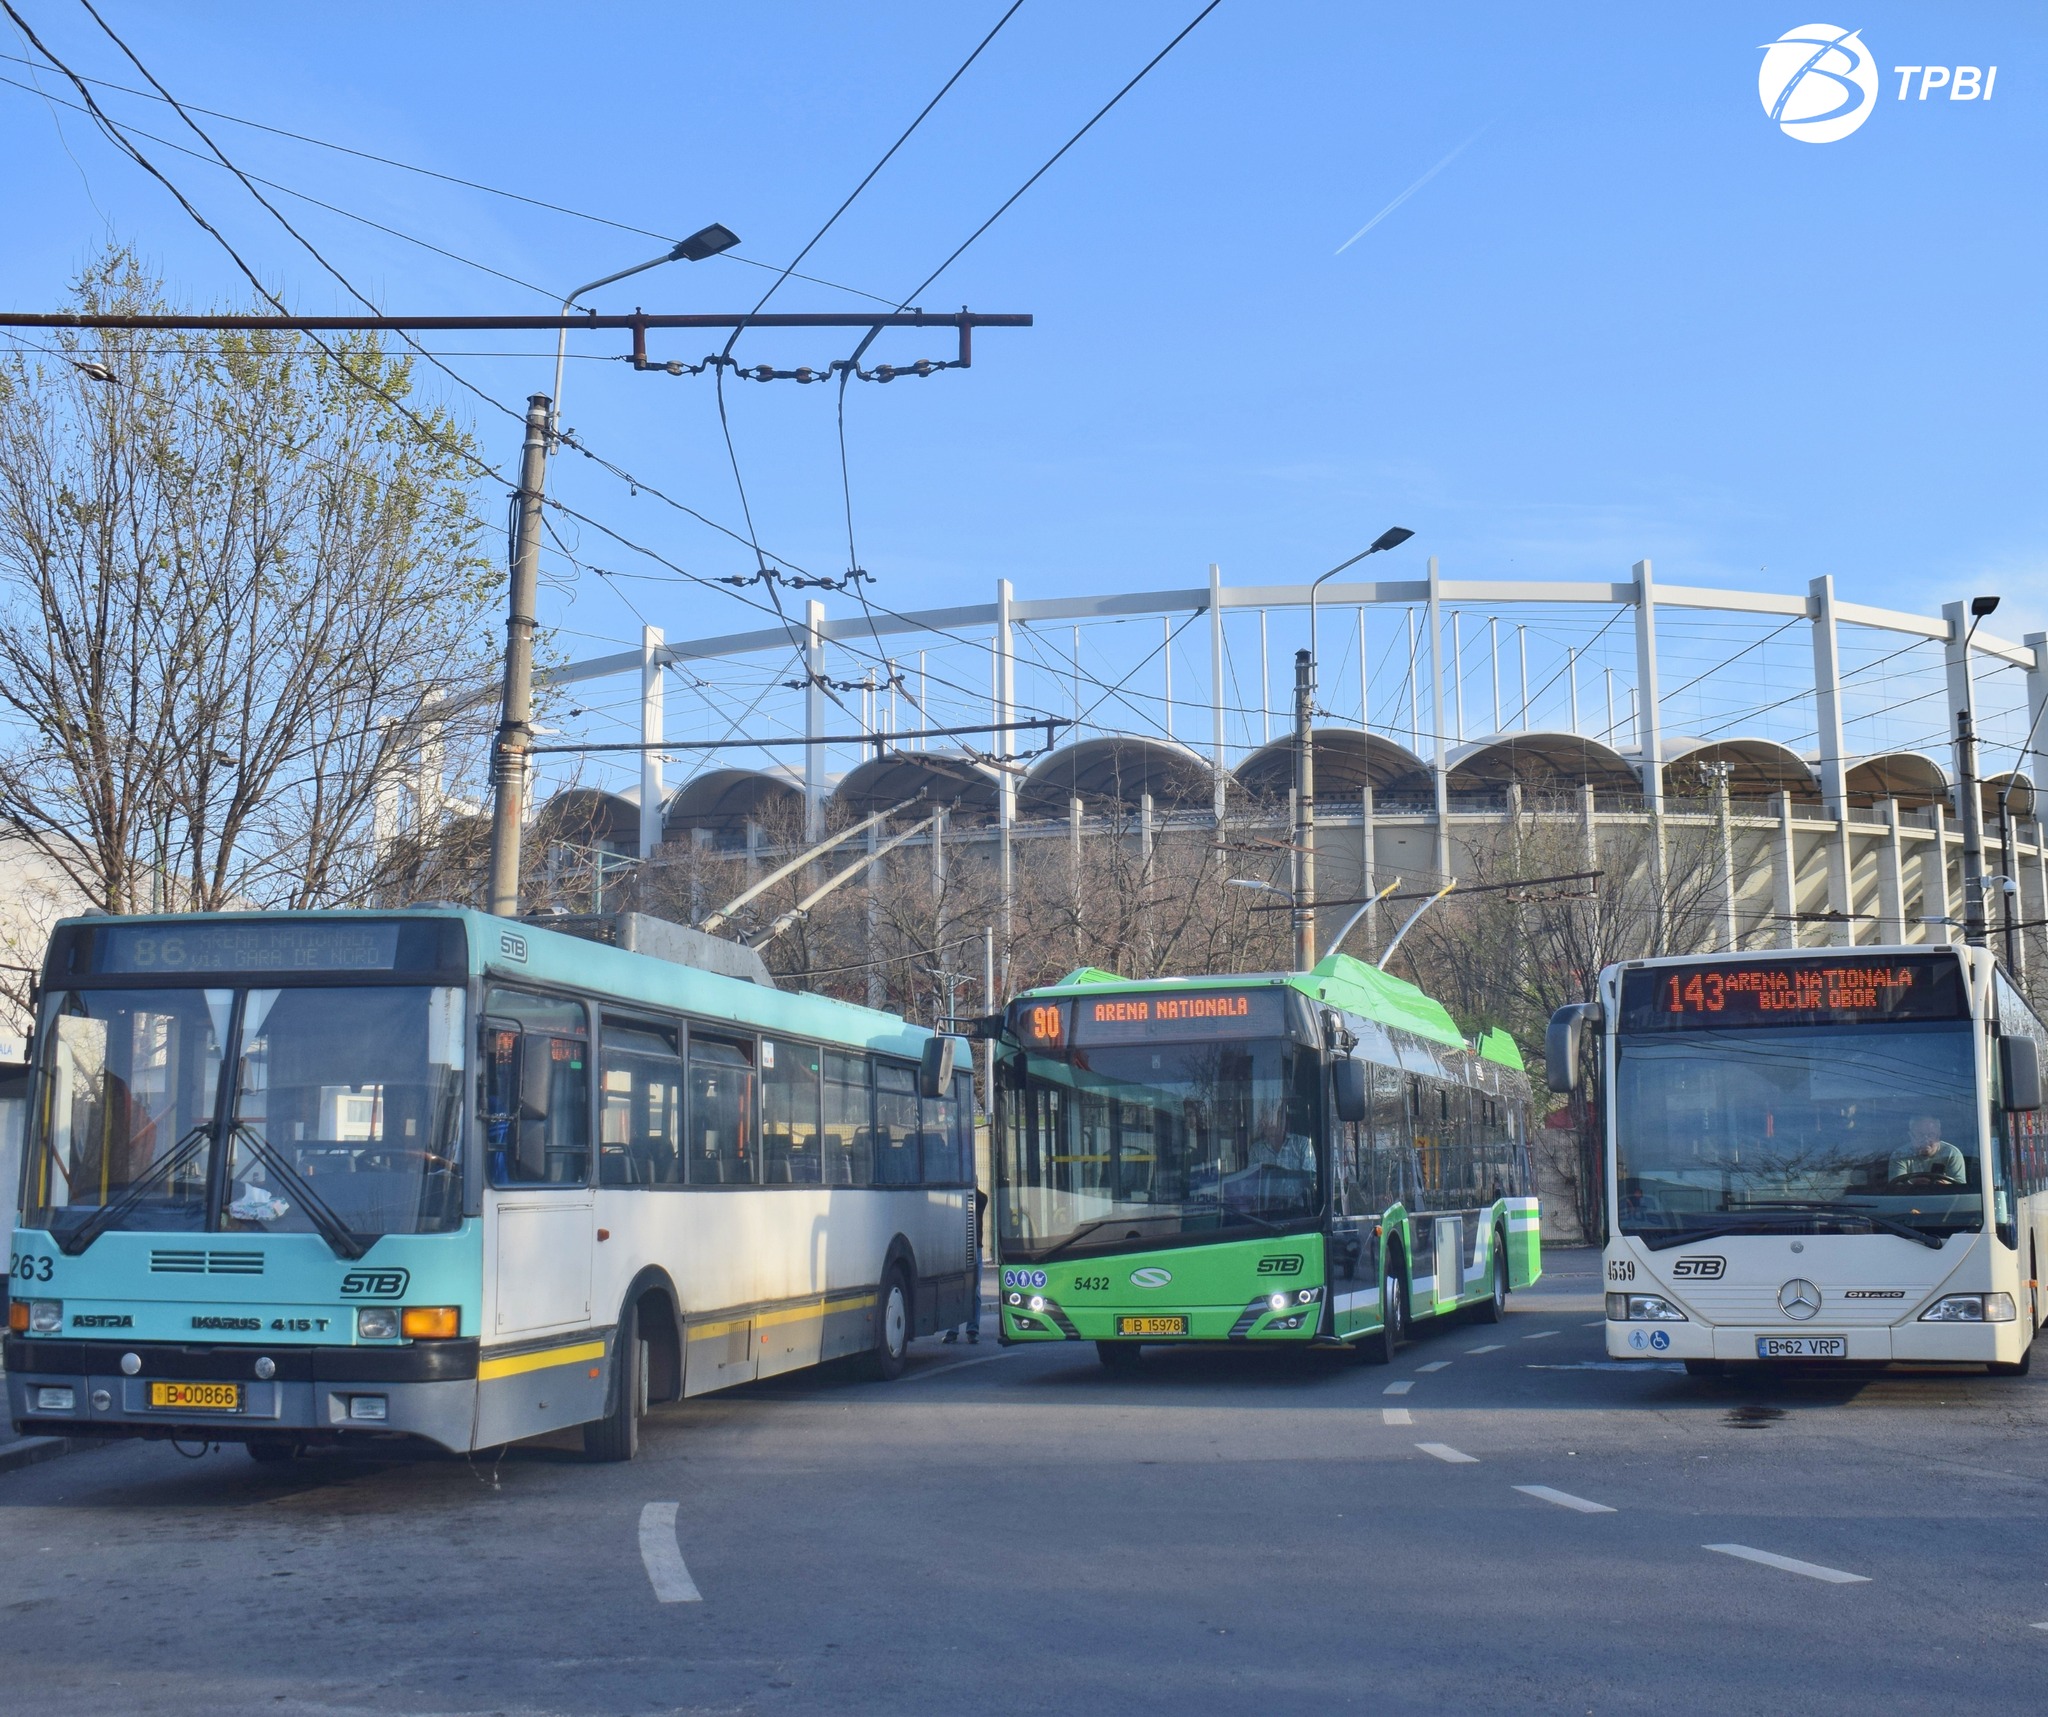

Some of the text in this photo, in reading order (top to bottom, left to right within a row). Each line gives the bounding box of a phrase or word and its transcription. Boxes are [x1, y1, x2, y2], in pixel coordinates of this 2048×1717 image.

[132, 937, 188, 966] 86
[500, 934, 526, 958] STB
[234, 950, 283, 967] GARA
[294, 949, 318, 966] DE
[331, 948, 380, 966] NORD
[1725, 968, 1913, 991] ARENA NATIONALA
[1669, 973, 1725, 1012] 143
[1759, 988, 1877, 1010] BUCUR OBOR
[1095, 998, 1248, 1021] ARENA NATIONALA
[1033, 1006, 1060, 1039] 90
[1256, 1257, 1302, 1273] STB
[1608, 1260, 1635, 1281] 4559
[1672, 1259, 1722, 1276] STB
[339, 1272, 405, 1294] STB
[1074, 1277, 1110, 1291] 5432
[1846, 1291, 1904, 1299] CITARO
[73, 1314, 134, 1327] ASTRA
[191, 1316, 262, 1331] IKARUS
[1148, 1319, 1180, 1331] 15978
[1808, 1340, 1840, 1355] VRP
